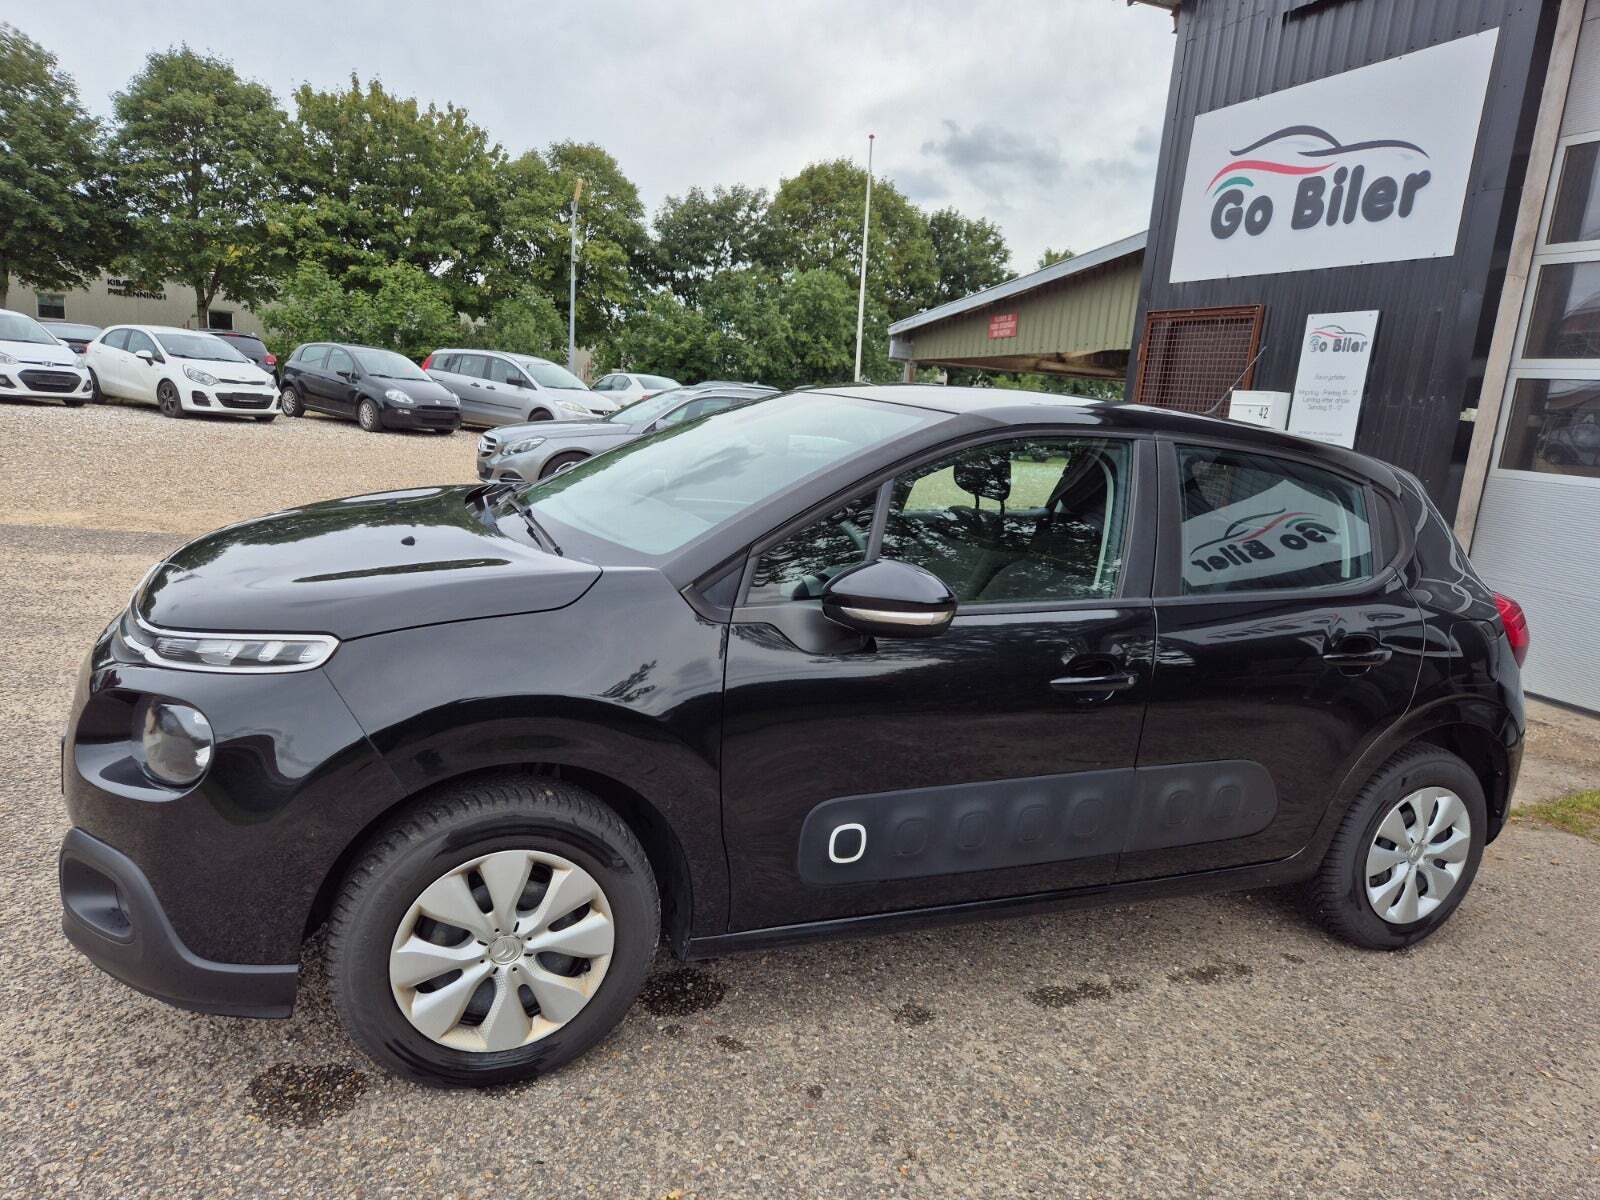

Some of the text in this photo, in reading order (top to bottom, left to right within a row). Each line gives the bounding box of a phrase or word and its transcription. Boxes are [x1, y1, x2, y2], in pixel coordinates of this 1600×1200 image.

[1210, 164, 1432, 240] Go Biler
[1310, 337, 1368, 352] Go Biler
[1258, 403, 1268, 418] 42
